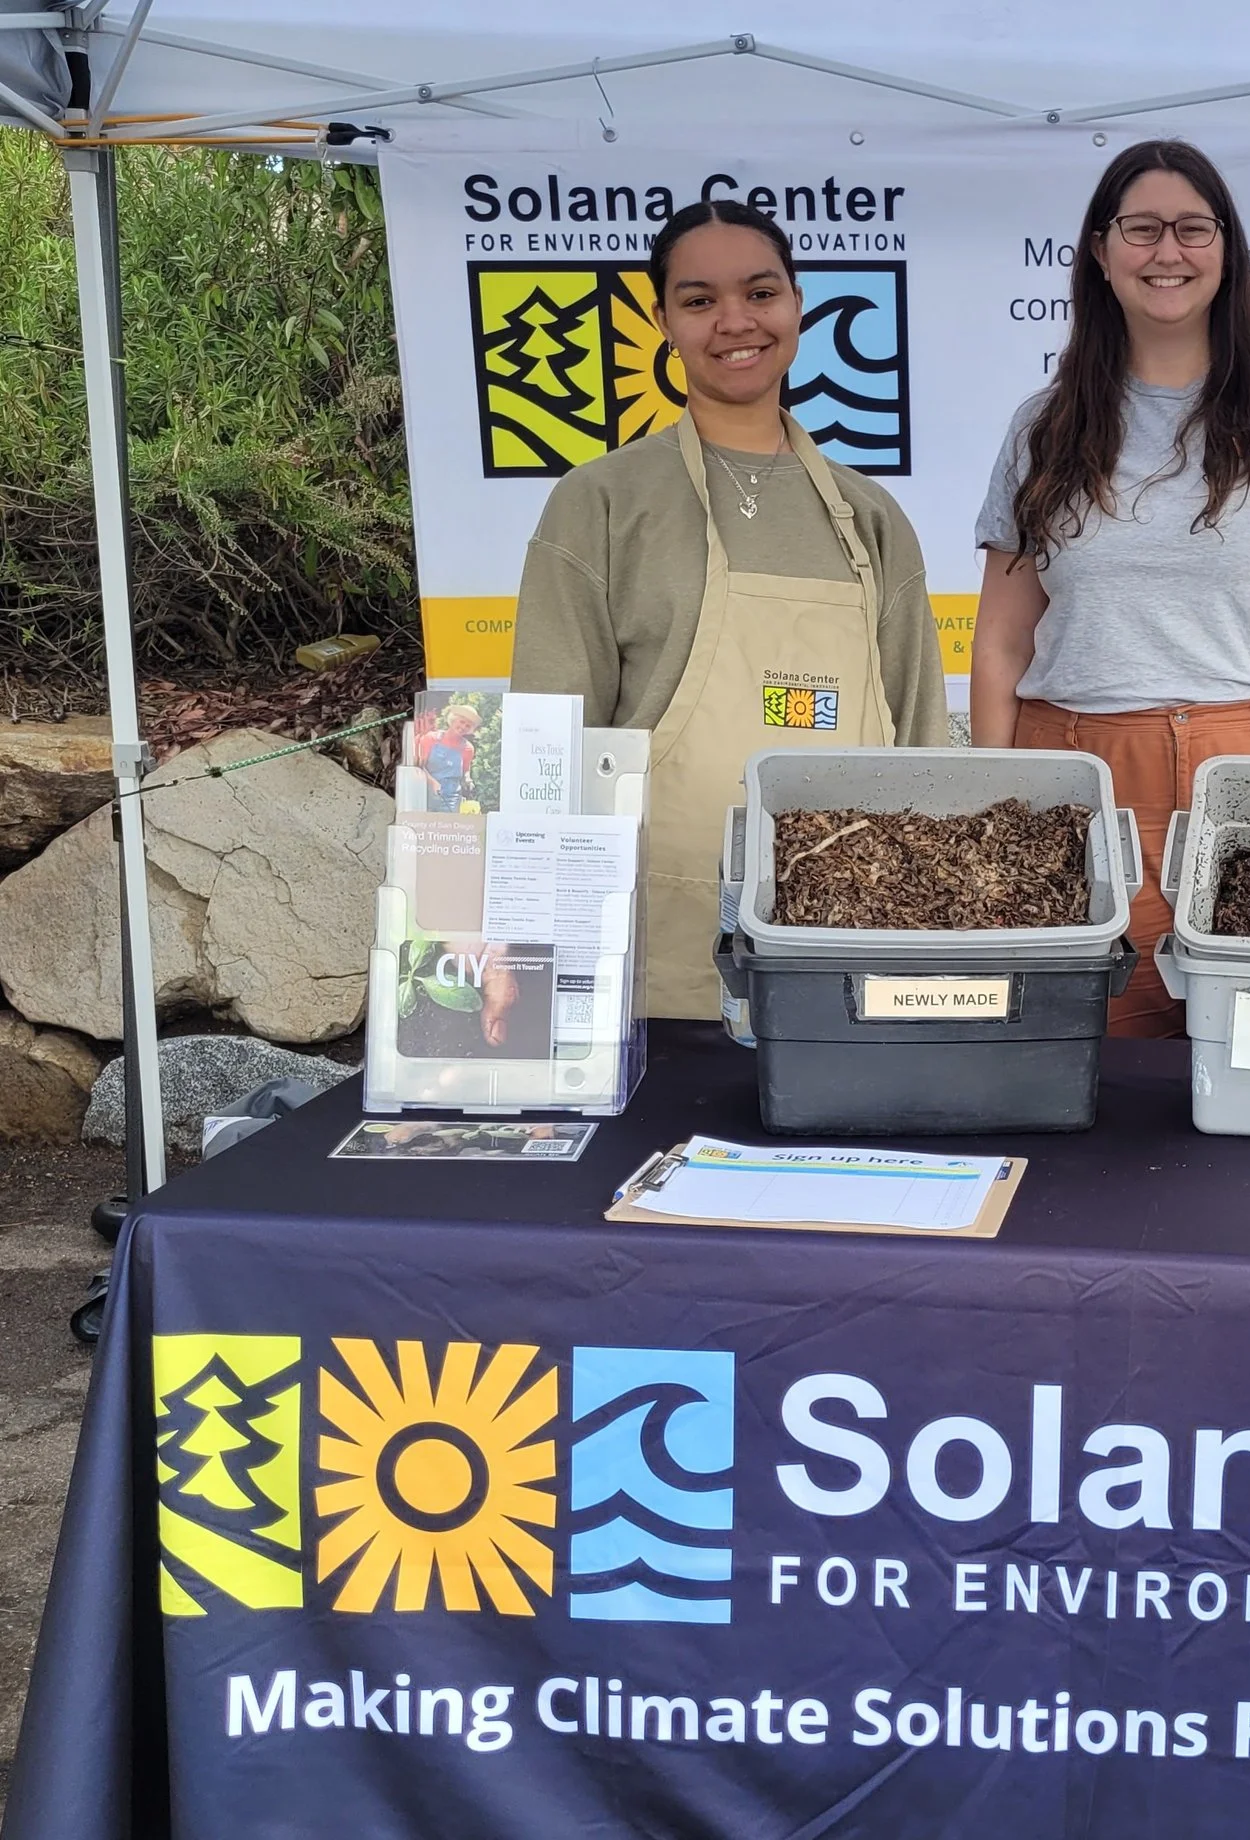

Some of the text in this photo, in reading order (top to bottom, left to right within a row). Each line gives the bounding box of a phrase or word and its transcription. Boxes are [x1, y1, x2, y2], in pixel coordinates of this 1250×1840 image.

[464, 174, 905, 222] Solana Center
[465, 234, 513, 251] FOR
[528, 234, 657, 251] ENVIRONM
[1025, 238, 1076, 267] Mo
[1010, 298, 1073, 321] com
[465, 619, 513, 633] COMP
[764, 669, 839, 684] Solana Center
[538, 758, 562, 776] Yard
[520, 783, 562, 801] Garden
[428, 831, 477, 843] Trimmings
[402, 842, 480, 855] Recycling Guide
[436, 953, 489, 988] CIY
[894, 993, 998, 1007] NEWLY MADE
[773, 1153, 923, 1165] Sign up here
[770, 1556, 910, 1608] FOR
[226, 1670, 515, 1752] Making
[536, 1676, 830, 1746] Climate
[852, 1686, 1208, 1758] Solutions
